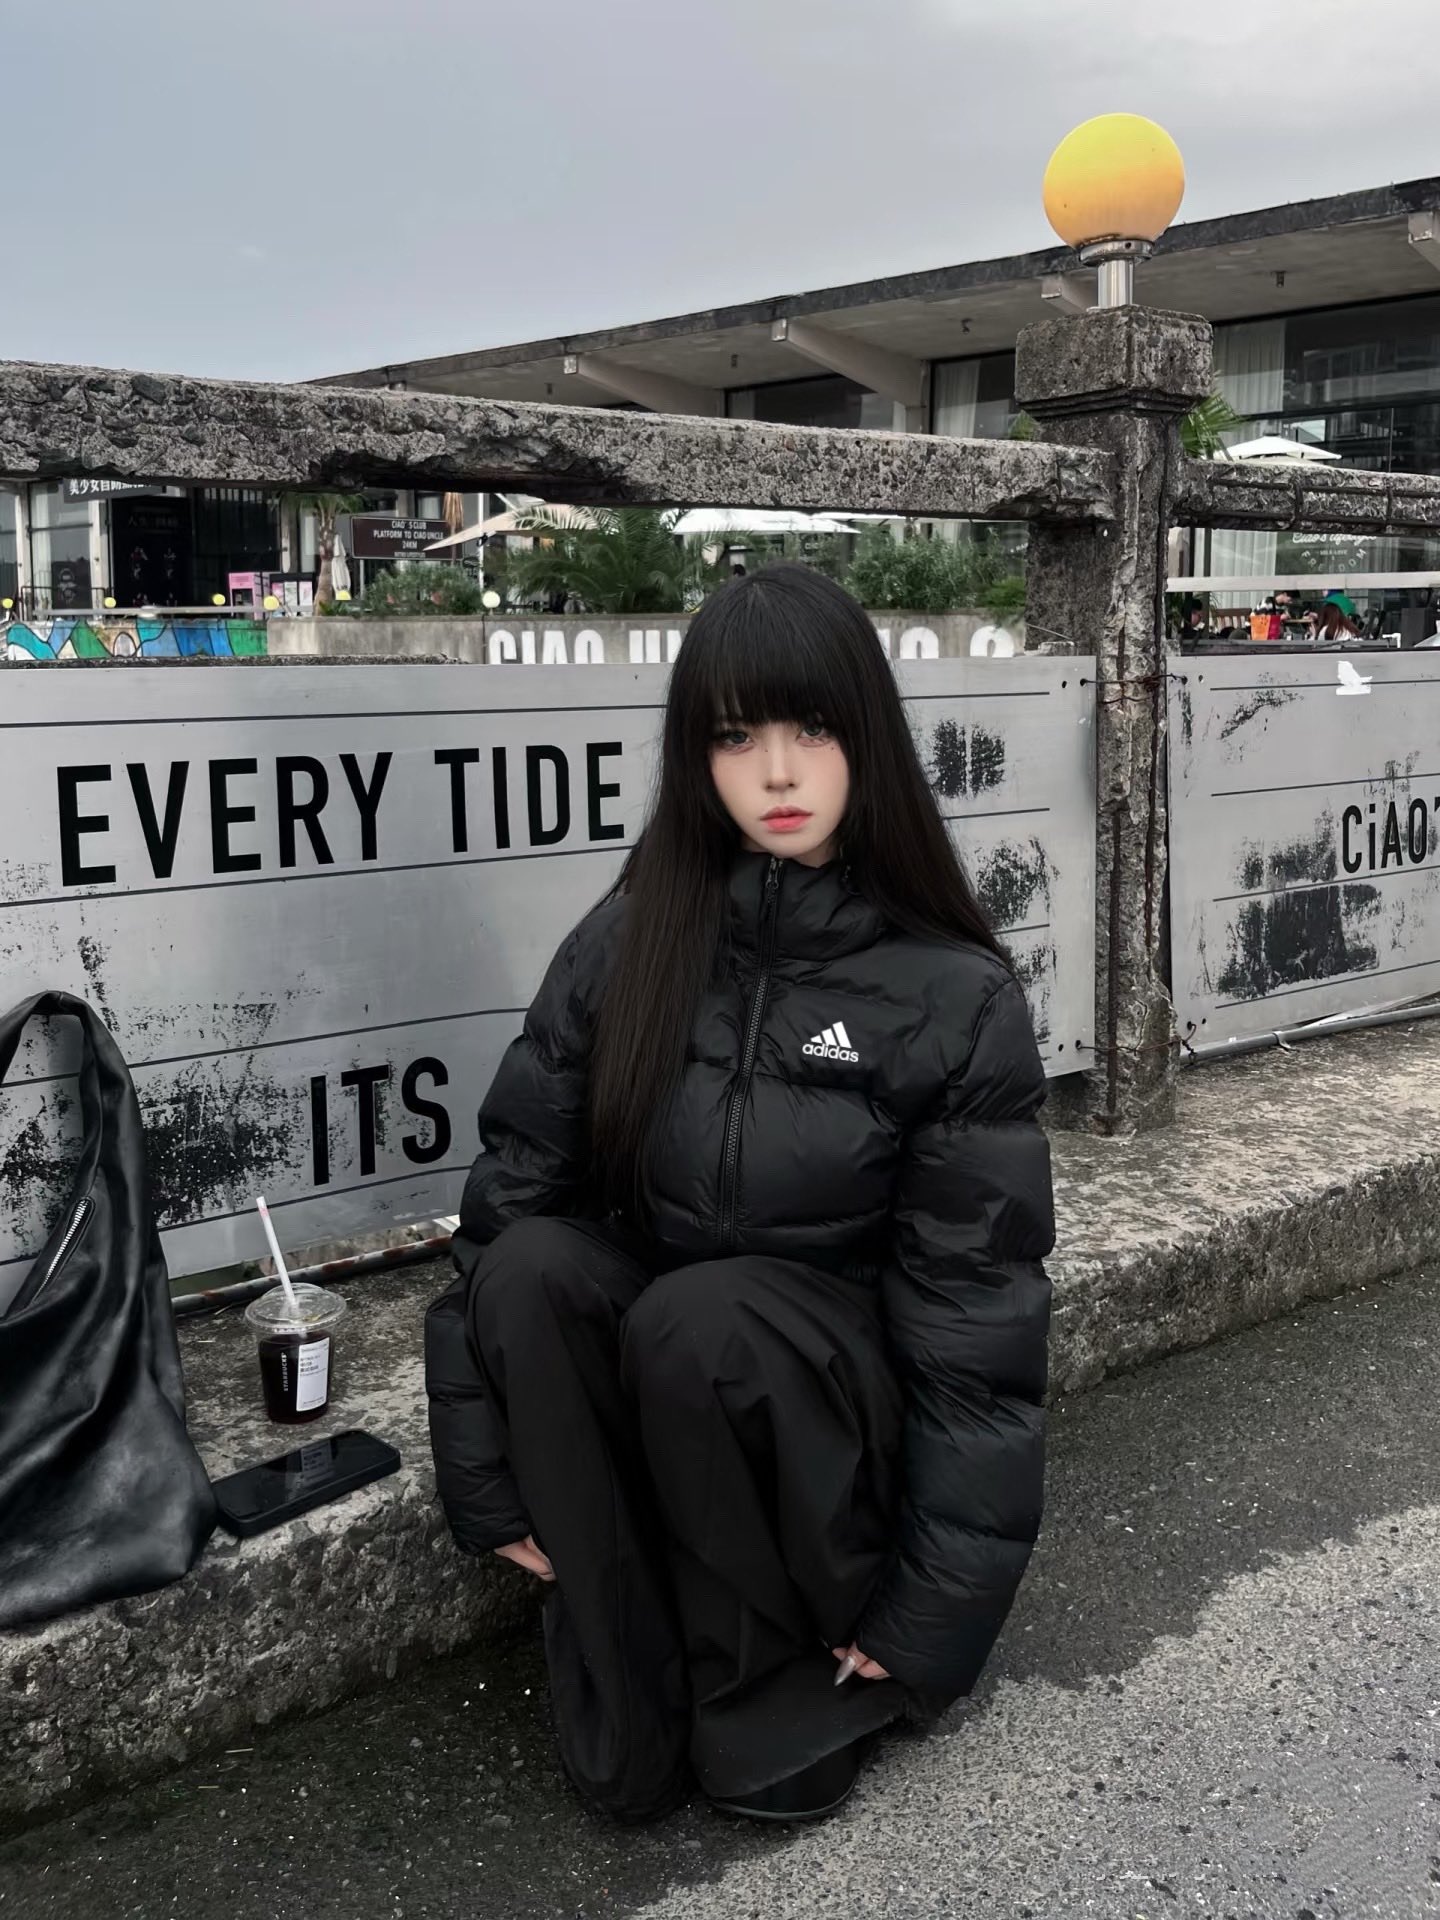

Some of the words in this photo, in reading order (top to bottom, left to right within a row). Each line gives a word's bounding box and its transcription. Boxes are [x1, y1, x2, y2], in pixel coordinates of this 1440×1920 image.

[373, 530, 403, 539] PLATFORM
[404, 531, 412, 539] TO
[56, 751, 393, 887] EVERY
[434, 741, 625, 853] TIDE
[802, 1043, 859, 1063] adidas
[310, 1056, 452, 1187] ITS
